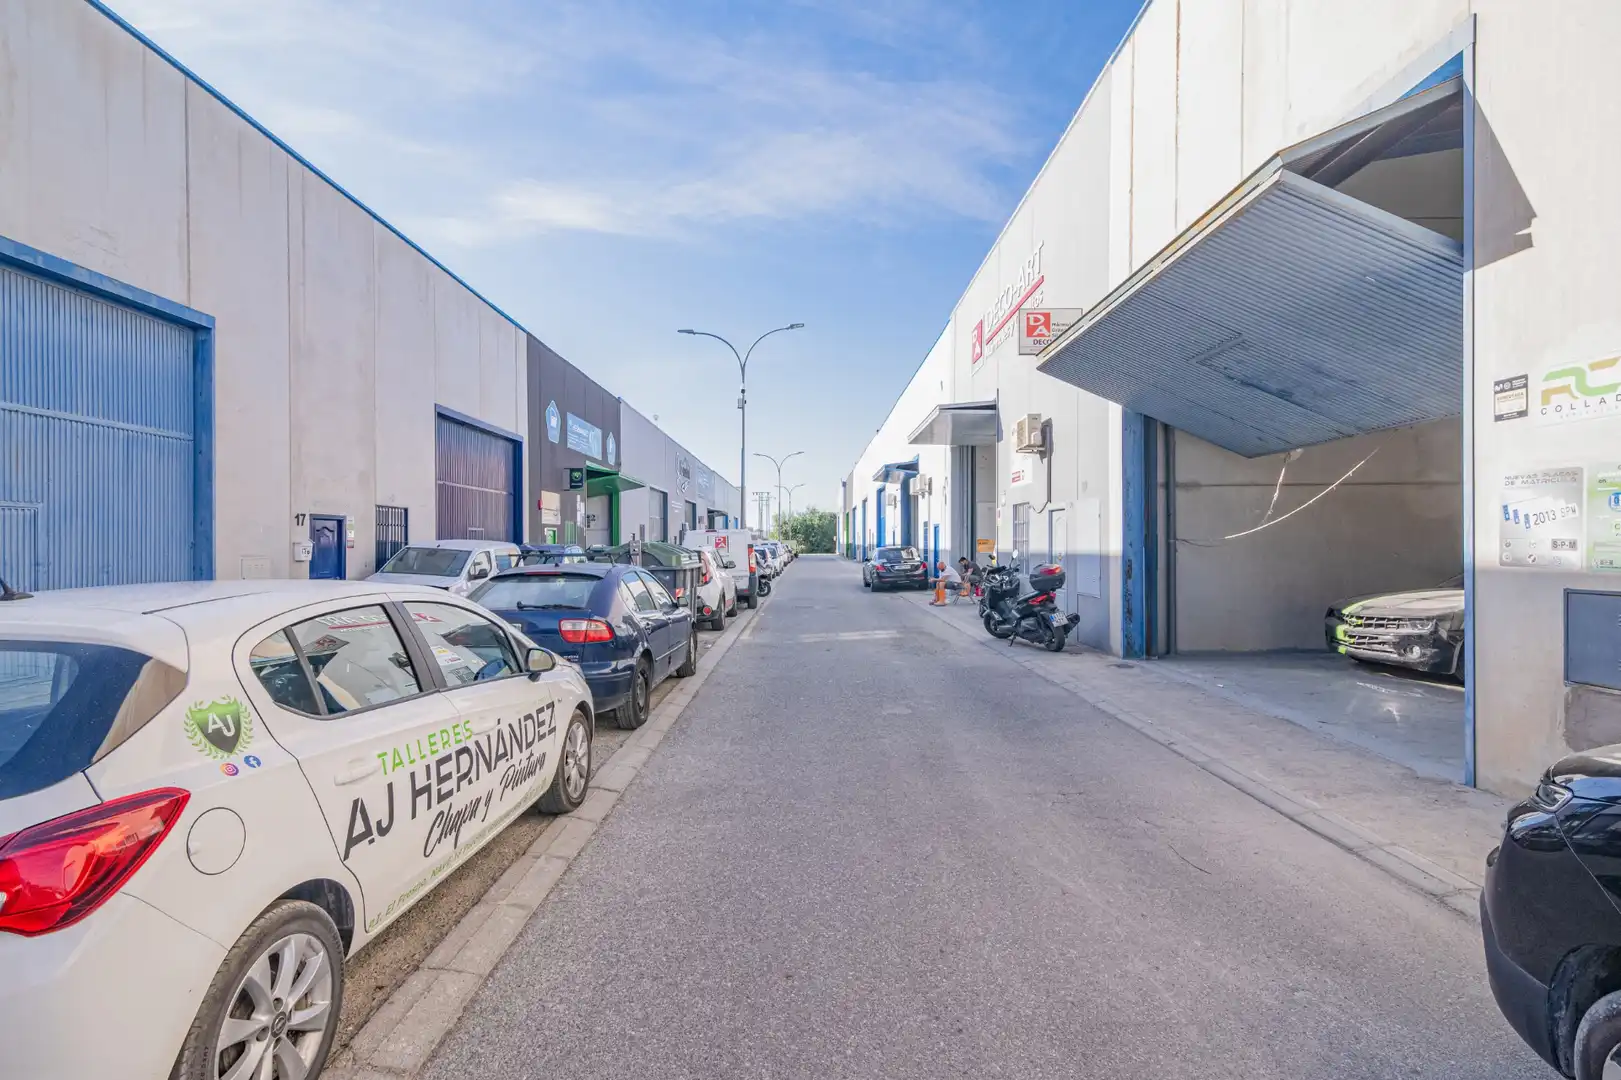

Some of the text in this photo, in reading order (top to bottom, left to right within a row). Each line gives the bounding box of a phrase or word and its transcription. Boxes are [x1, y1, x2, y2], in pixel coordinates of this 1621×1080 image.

[1504, 473, 1538, 481] NUEVAS
[294, 513, 306, 526] 17
[1532, 509, 1557, 526] 2013
[207, 712, 236, 737] AJ
[376, 720, 473, 776] TALLERES
[343, 701, 557, 862] AJ HERNÁNDEZ
[423, 802, 483, 858] Chapa
[481, 788, 494, 823] y
[499, 750, 548, 802] Pintura
